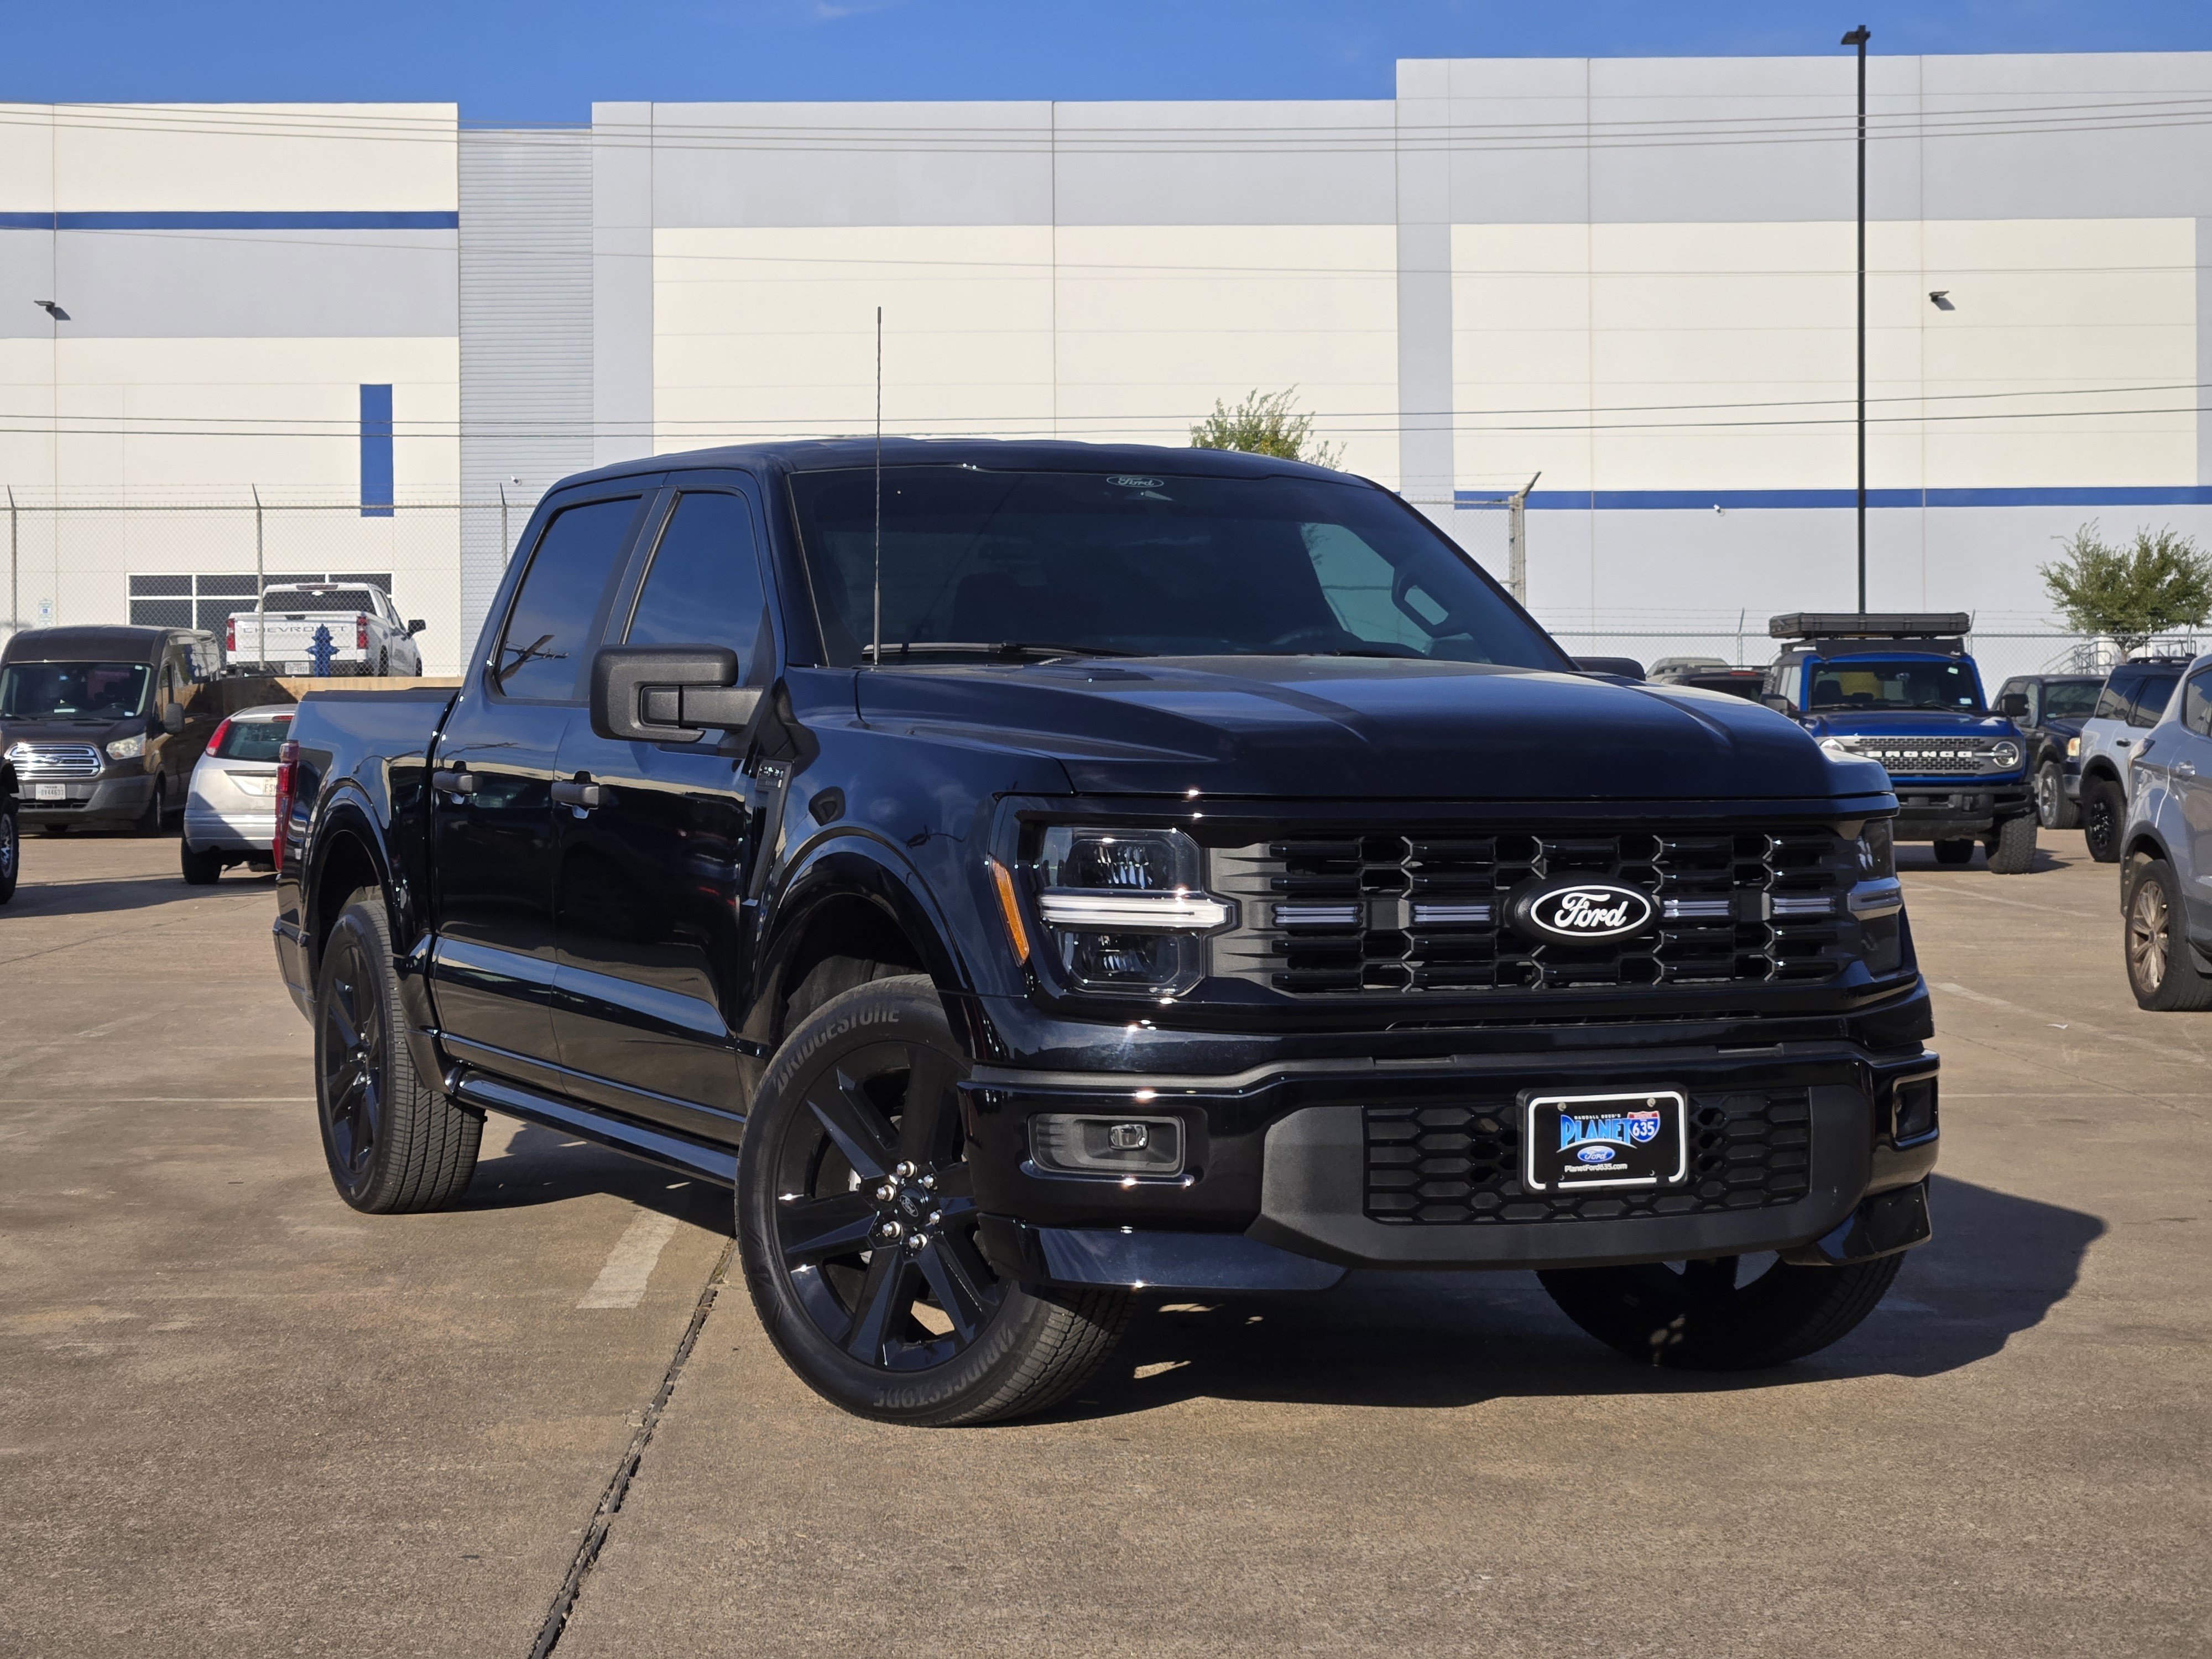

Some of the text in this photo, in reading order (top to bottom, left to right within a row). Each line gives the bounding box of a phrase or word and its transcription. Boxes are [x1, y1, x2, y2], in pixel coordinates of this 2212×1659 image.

[1118, 476, 1154, 486] Ford
[1554, 892, 1629, 927] Ford
[774, 1003, 900, 1097] BRIDGESTONE
[1561, 1114, 1632, 1149] PLANET
[1632, 1121, 1655, 1136] 635
[1584, 1150, 1607, 1160] Ford
[1564, 1162, 1627, 1172] PlanetFord635.com
